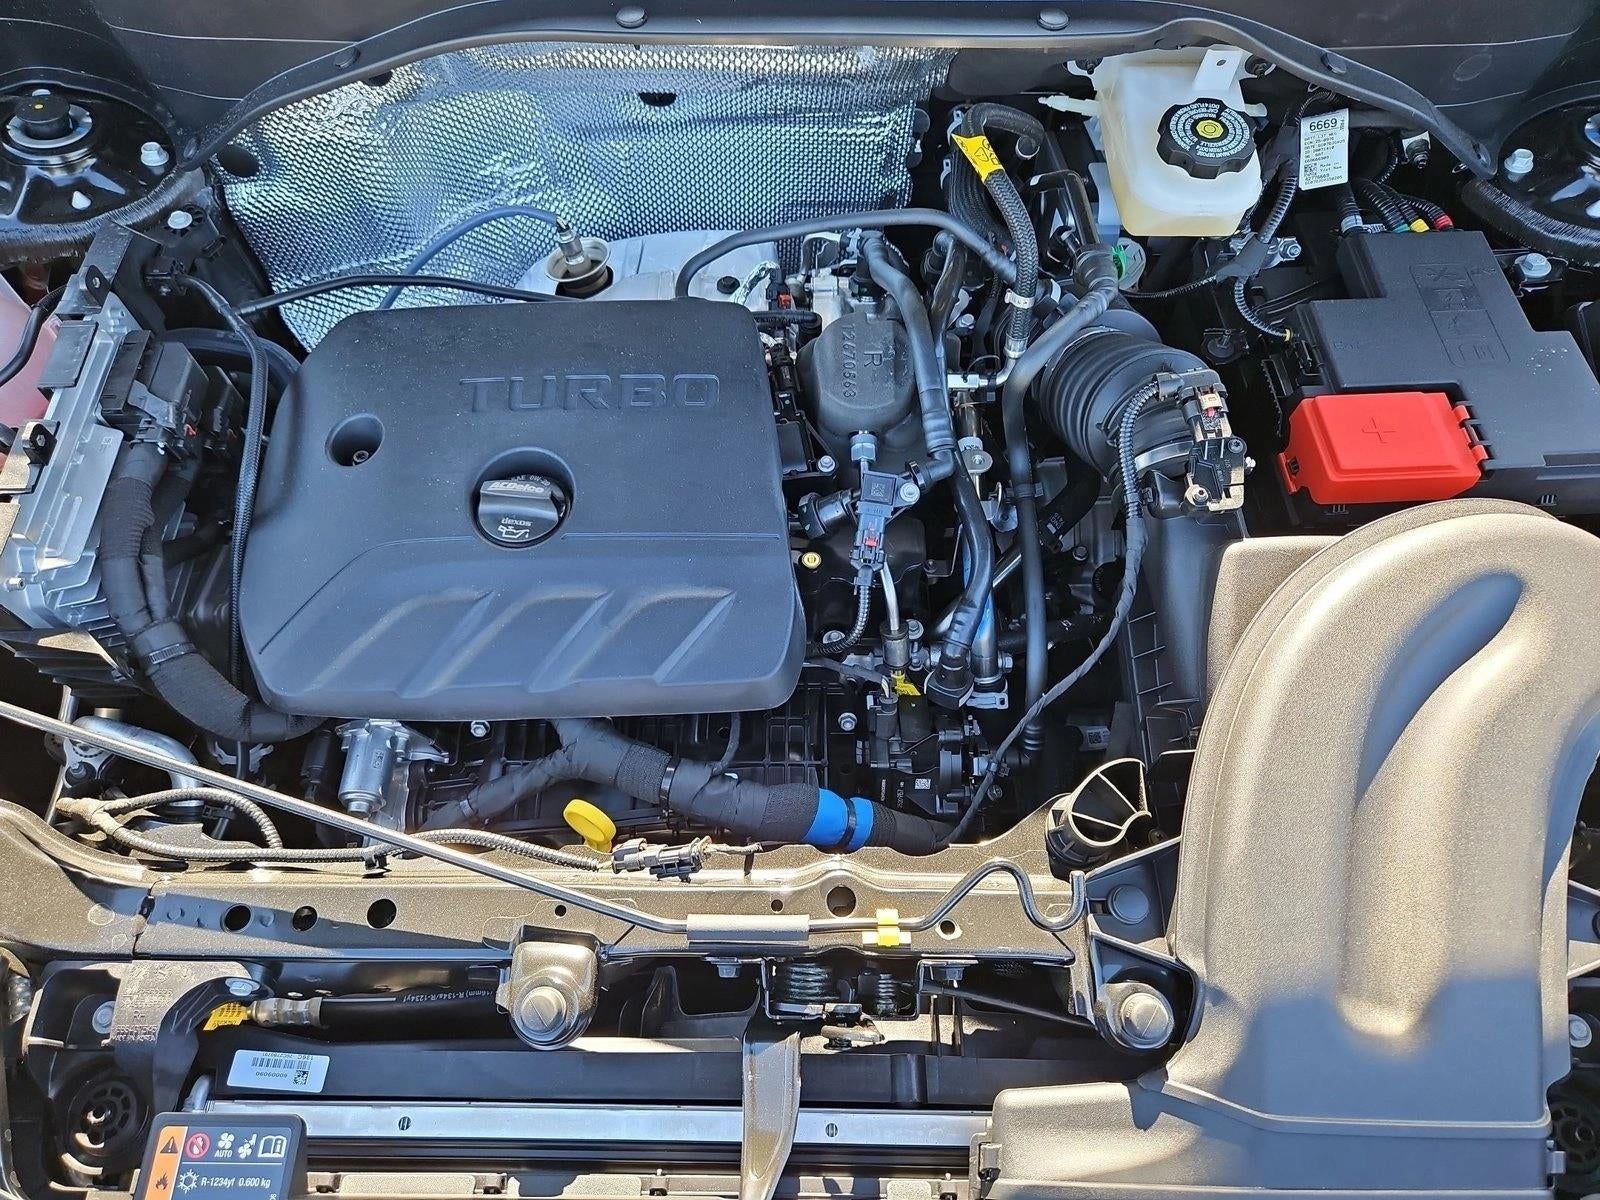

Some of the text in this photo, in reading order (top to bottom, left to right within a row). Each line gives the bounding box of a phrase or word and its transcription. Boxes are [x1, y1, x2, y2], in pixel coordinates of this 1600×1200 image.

[1309, 118, 1338, 131] 6669
[459, 373, 720, 412] TURBO
[487, 481, 545, 493] ACDelco
[501, 517, 533, 526] dexos
[214, 1150, 232, 1158] AUTO
[201, 1178, 271, 1188] R-1234yf 0.600 kg
